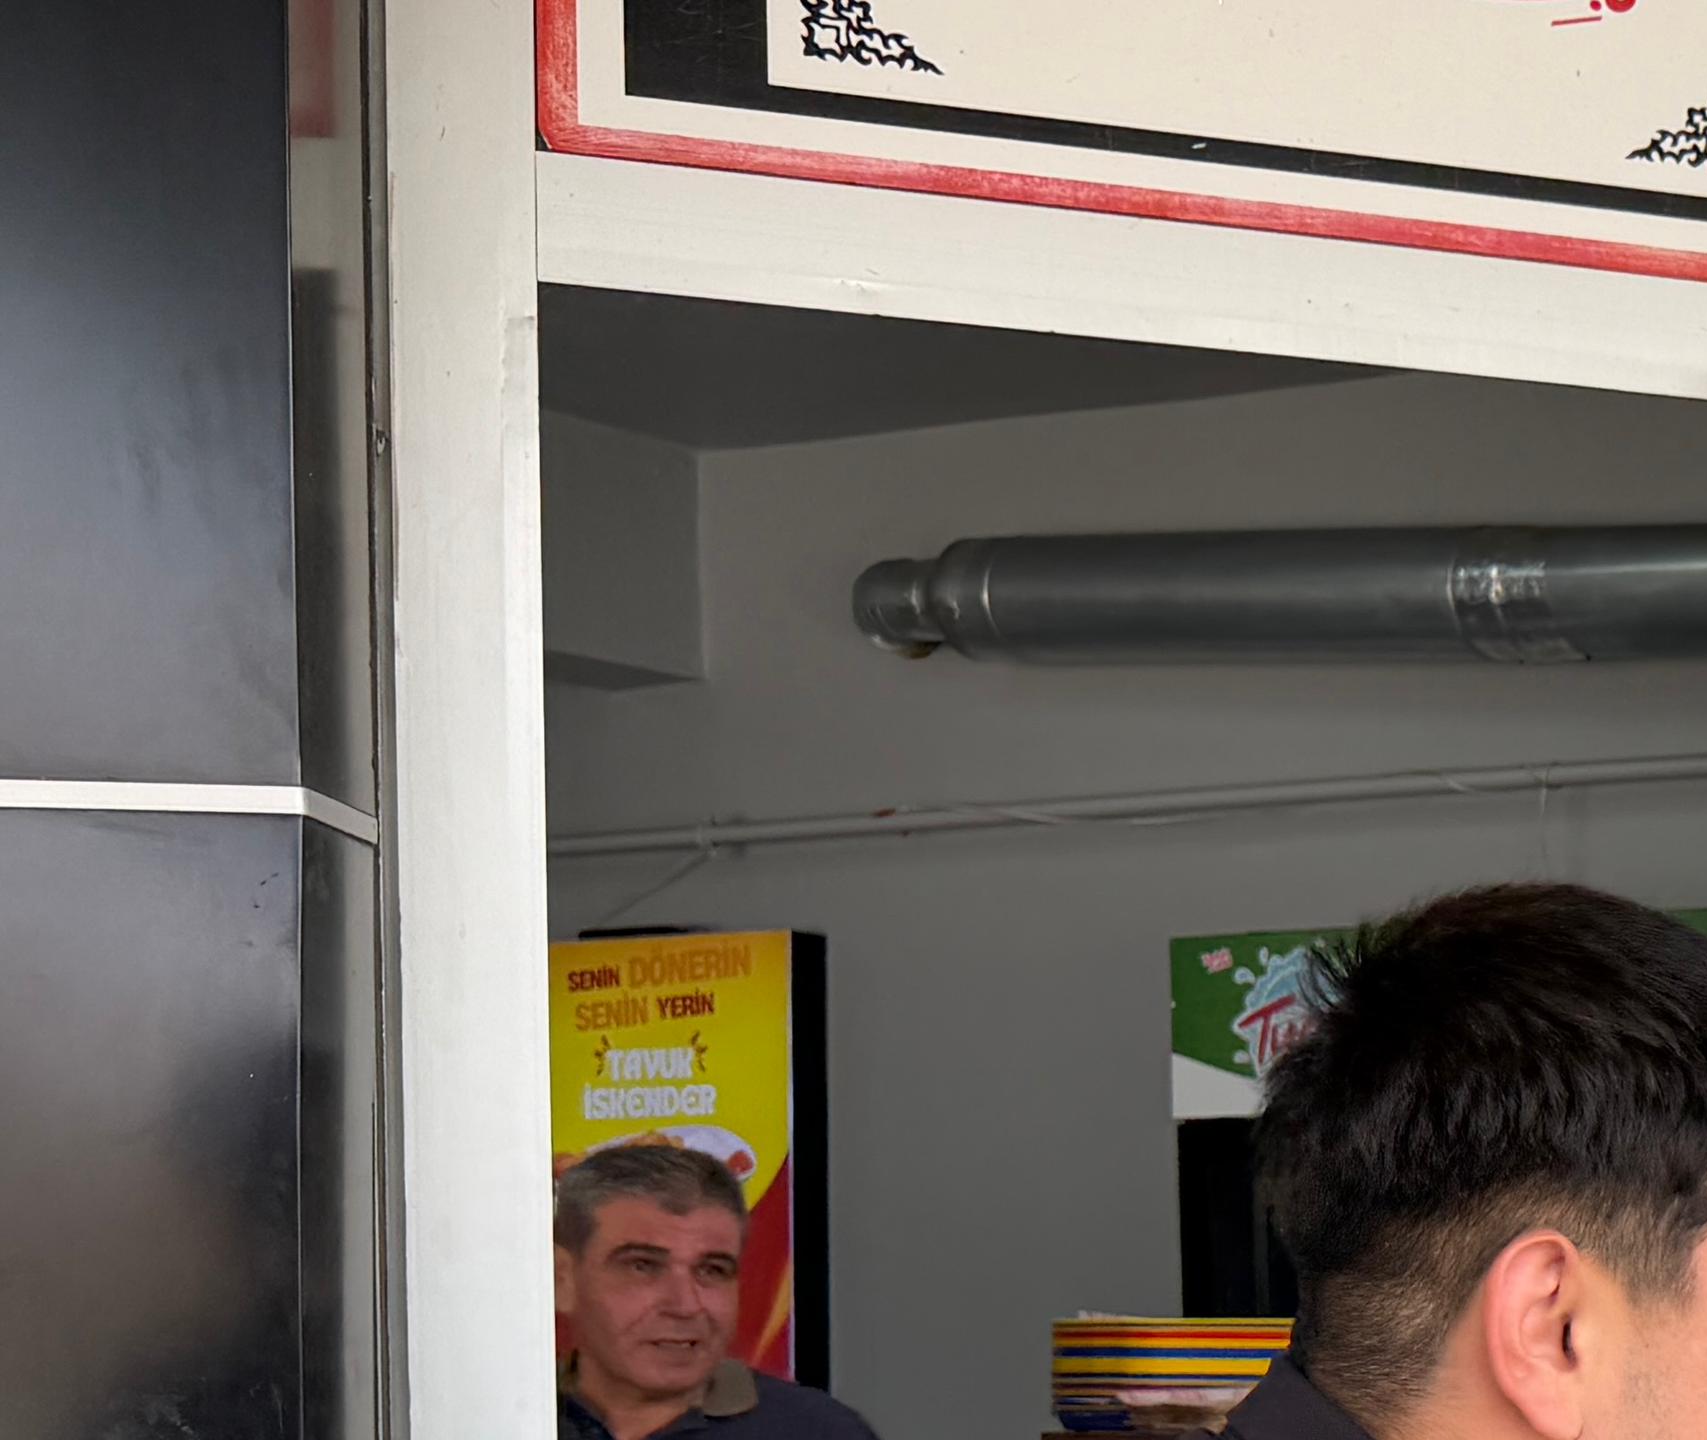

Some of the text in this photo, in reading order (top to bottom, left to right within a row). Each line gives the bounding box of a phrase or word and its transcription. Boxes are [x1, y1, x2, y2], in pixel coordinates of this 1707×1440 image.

[568, 941, 750, 993] SENİN DÖNERİN
[575, 988, 715, 1032] SENİN YERİN
[605, 1047, 695, 1082] TAVUK
[583, 1082, 717, 1121] İSKENDER
